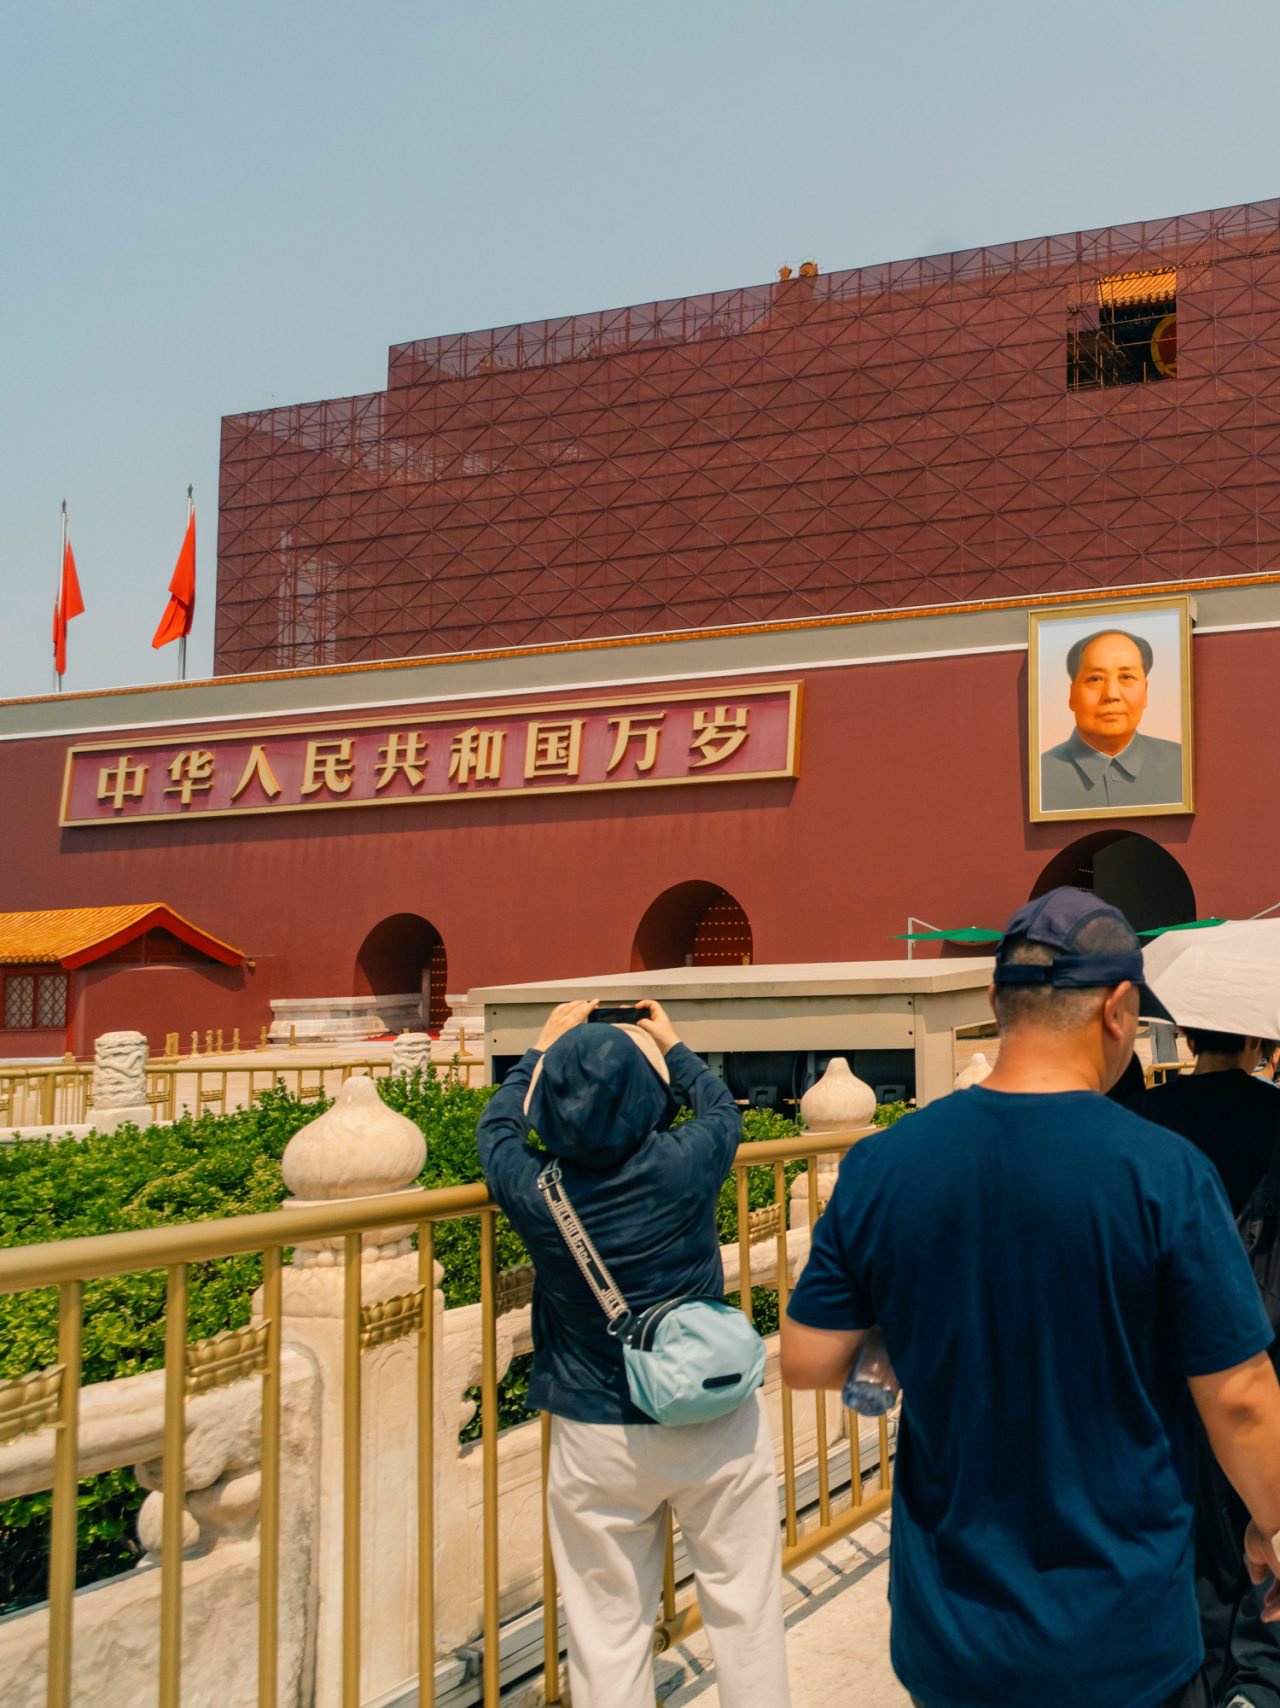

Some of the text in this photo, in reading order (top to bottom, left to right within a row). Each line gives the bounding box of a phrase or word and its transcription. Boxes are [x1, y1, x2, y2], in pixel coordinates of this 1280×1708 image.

[96, 706, 750, 810] 中华人民共和国万岁
